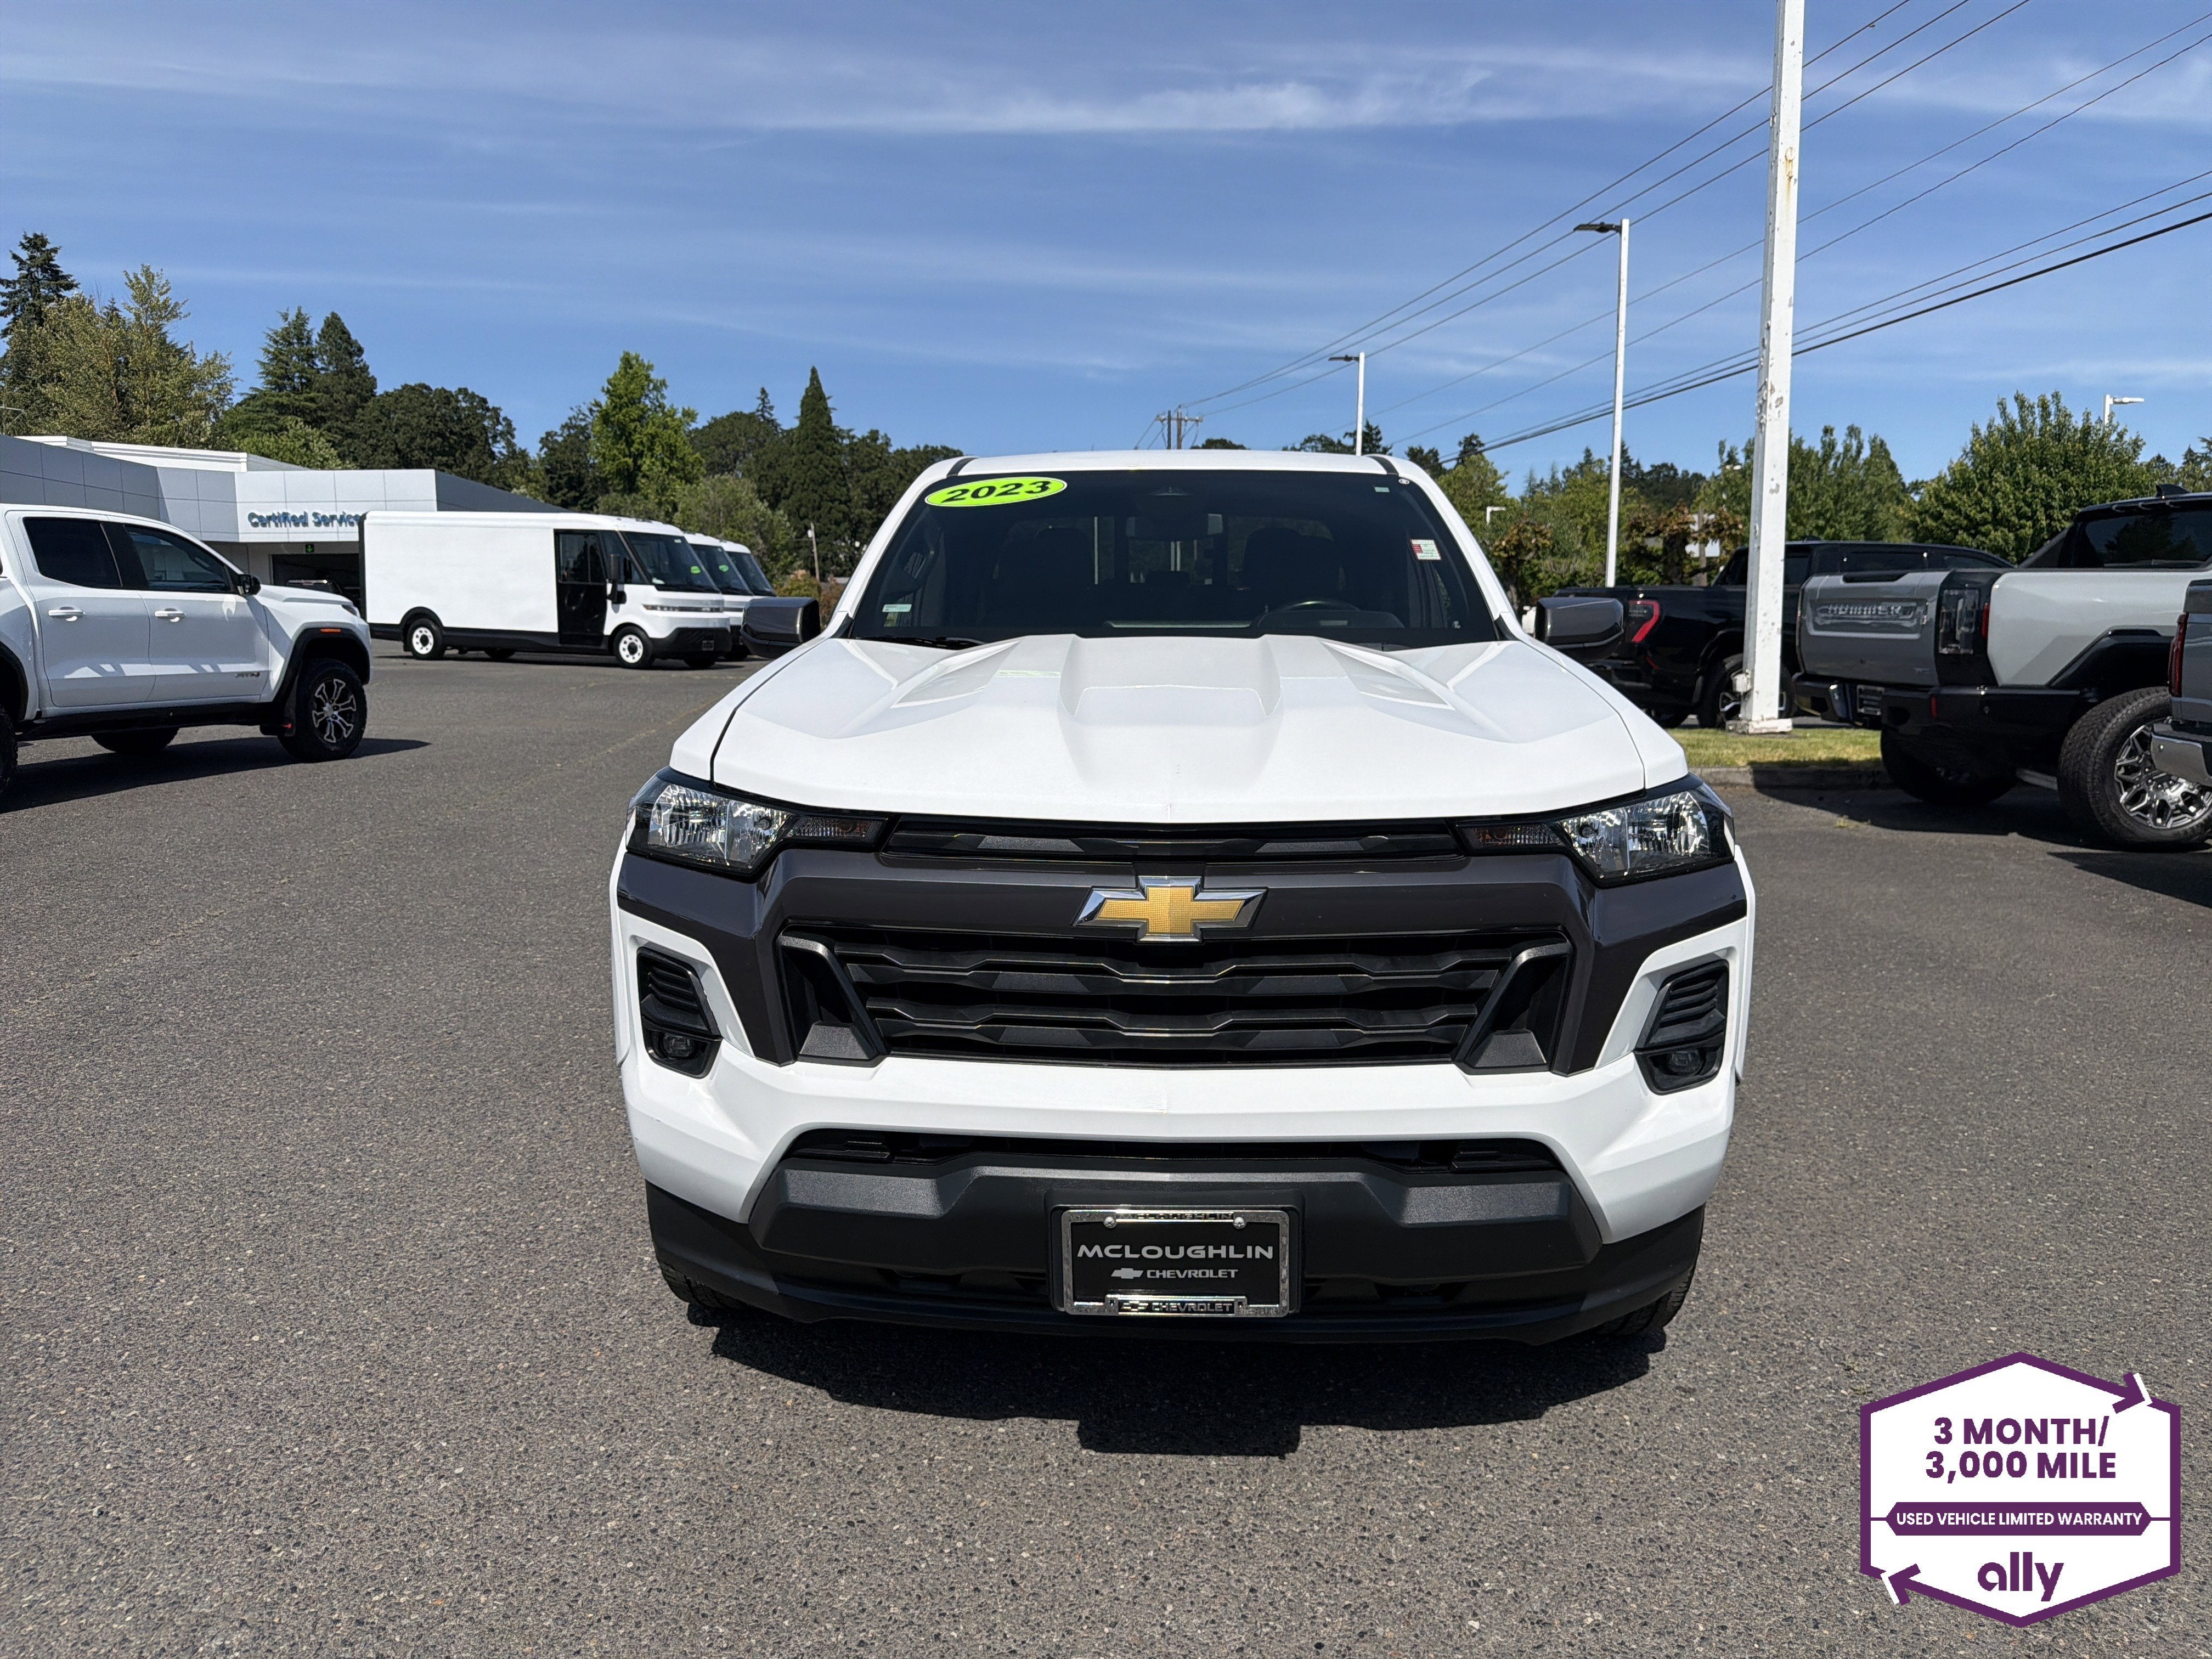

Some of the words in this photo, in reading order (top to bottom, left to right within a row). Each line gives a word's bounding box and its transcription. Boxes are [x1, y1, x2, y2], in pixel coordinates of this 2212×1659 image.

[941, 481, 1052, 504] 2023
[247, 511, 309, 528] Certified
[1077, 1244, 1273, 1259] MCLOUGHLIN
[1147, 1269, 1239, 1278] CHEVROLET
[1152, 1302, 1232, 1312] CHEVROLET
